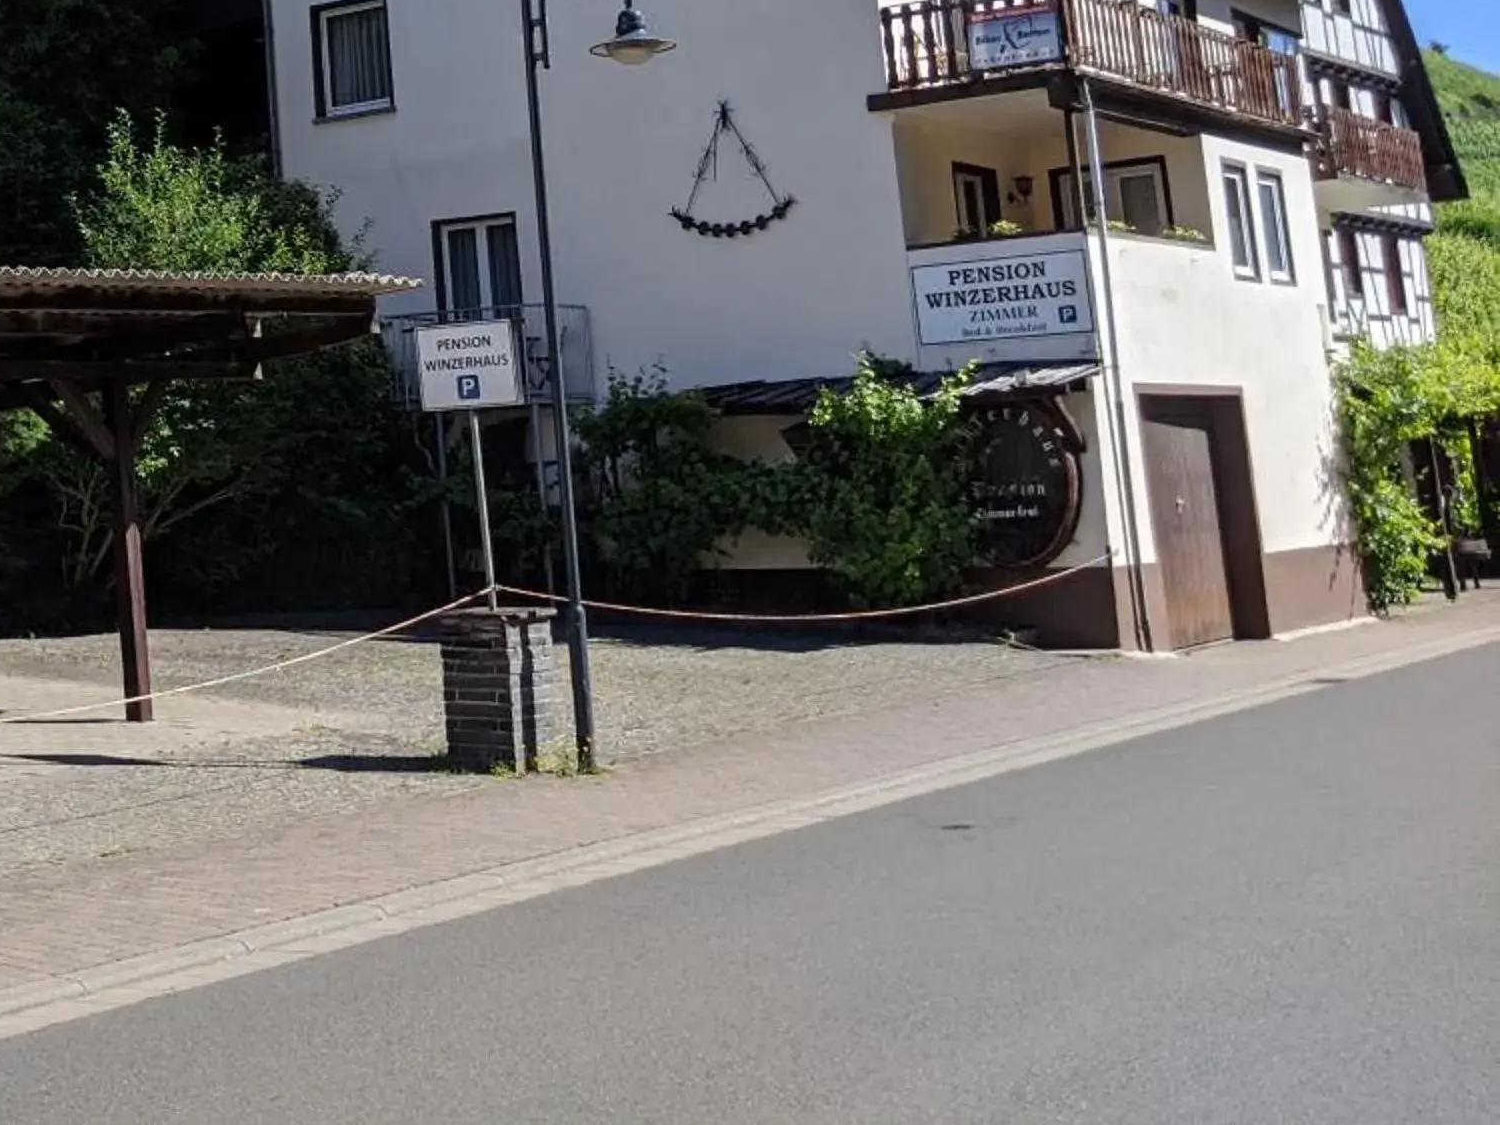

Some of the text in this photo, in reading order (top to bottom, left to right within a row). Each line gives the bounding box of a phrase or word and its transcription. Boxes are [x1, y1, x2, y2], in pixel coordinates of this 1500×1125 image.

[948, 261, 1046, 286] PENSION
[924, 281, 1077, 309] WINZERHAUS
[969, 306, 1039, 323] ZIMMER
[436, 335, 491, 351] PENSION
[424, 354, 509, 372] WINZERHAUS
